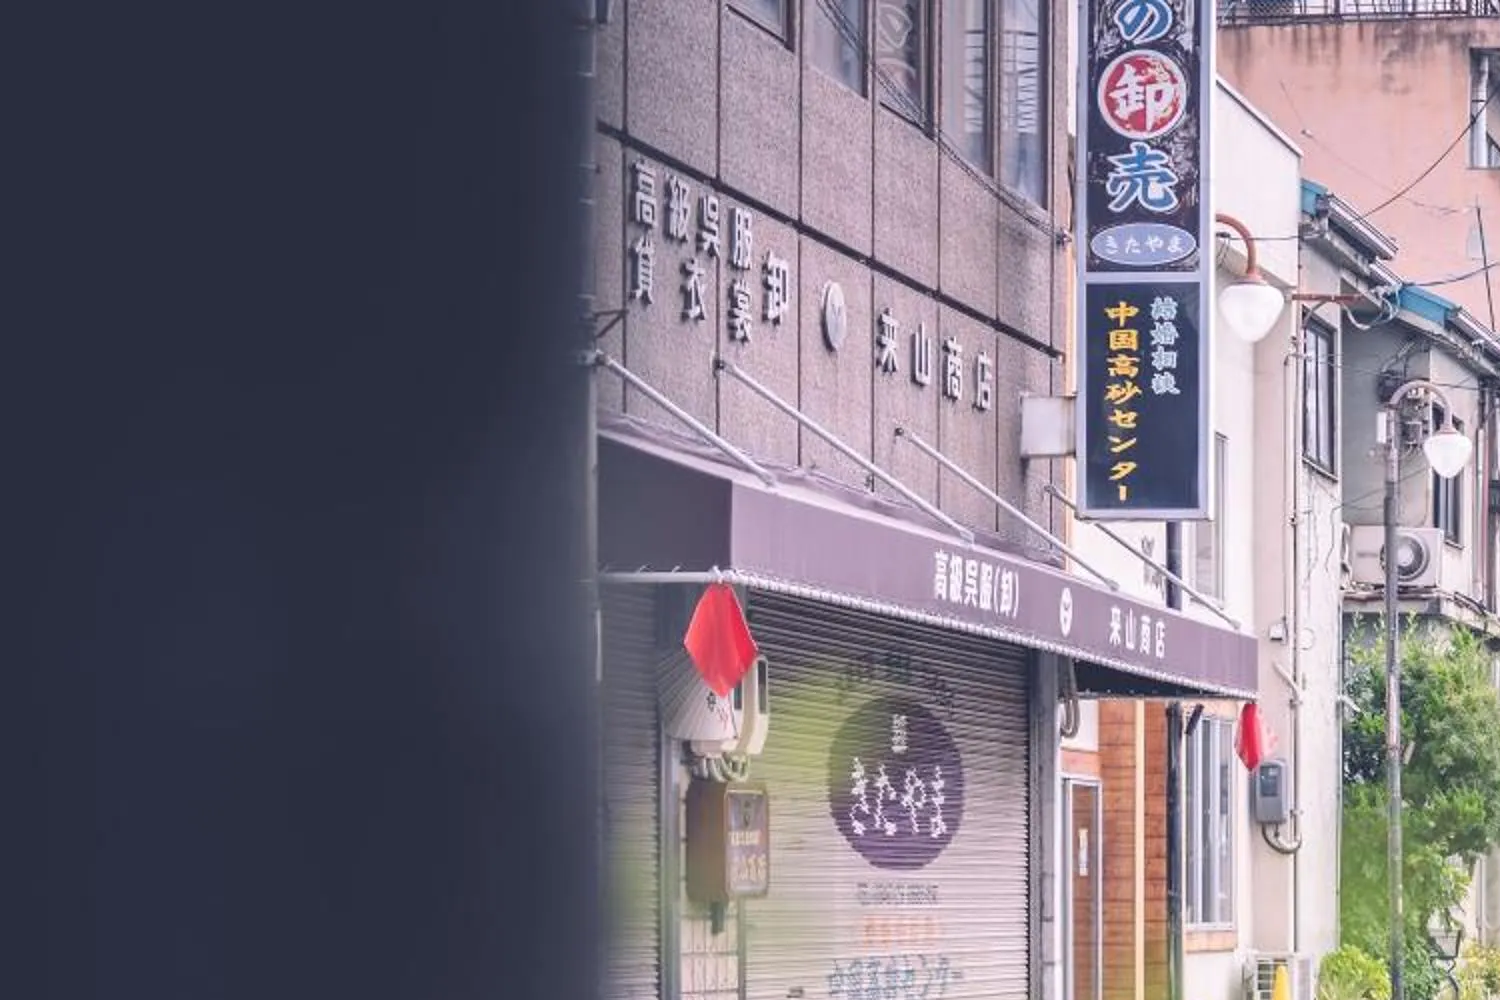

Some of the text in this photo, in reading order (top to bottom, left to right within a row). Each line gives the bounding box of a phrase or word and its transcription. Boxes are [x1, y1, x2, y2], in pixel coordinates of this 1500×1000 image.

[1105, 235, 1182, 255] きたやま
[1150, 296, 1181, 395] 結婚相談
[1104, 301, 1142, 502] 中国高砂センター
